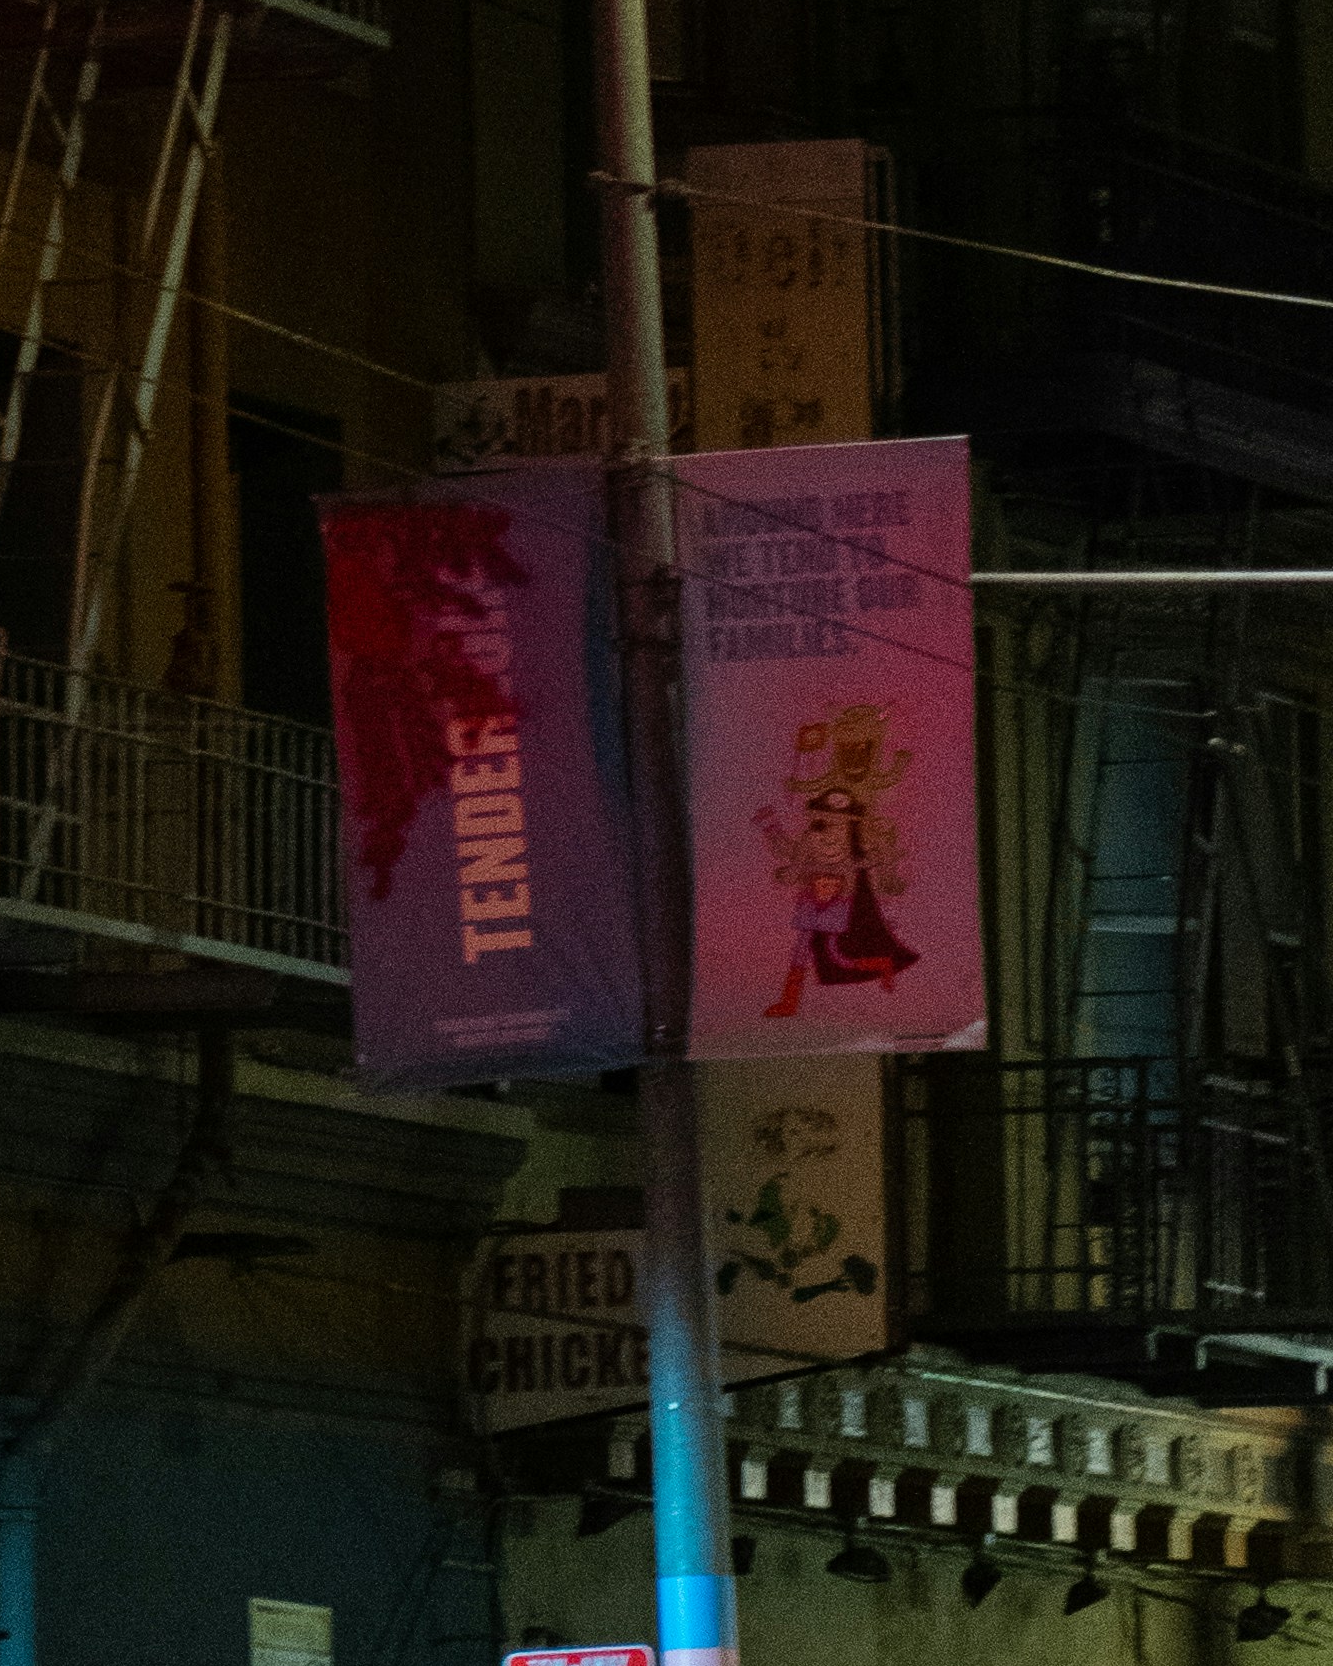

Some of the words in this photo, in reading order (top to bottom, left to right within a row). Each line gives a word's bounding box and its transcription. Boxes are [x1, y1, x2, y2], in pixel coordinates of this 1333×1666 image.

[760, 537, 838, 576] TEND
[494, 1249, 634, 1308] FRIED
[467, 1323, 651, 1393] CHICKE
